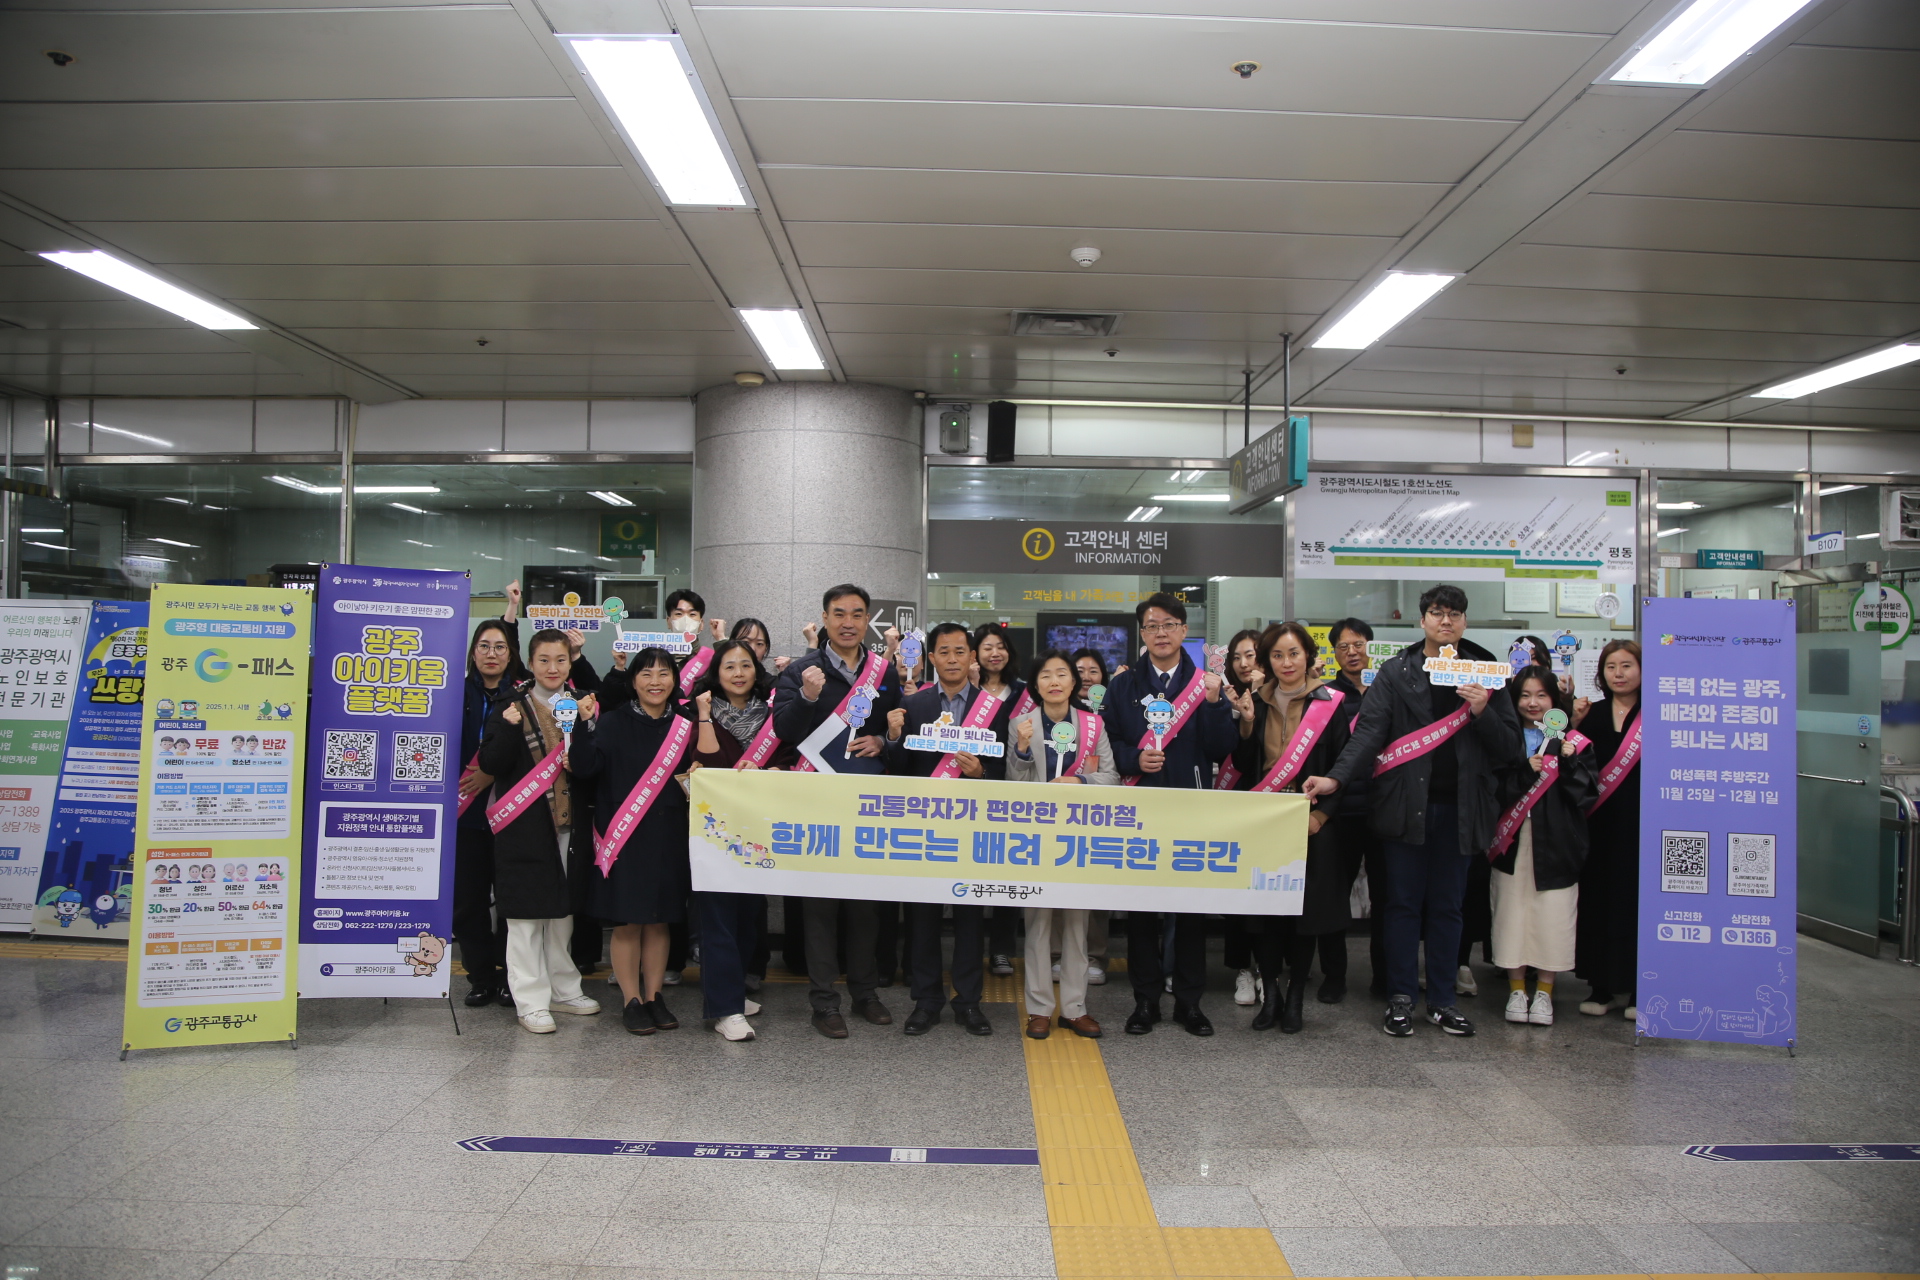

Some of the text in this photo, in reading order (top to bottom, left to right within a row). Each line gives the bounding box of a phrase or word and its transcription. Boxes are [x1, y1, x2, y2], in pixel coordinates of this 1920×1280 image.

[1246, 428, 1284, 474] 고객안내센터
[1247, 462, 1280, 494] INFORMATION
[1319, 477, 1453, 488] 광주광역시도시철도 1호선 노선도
[1320, 487, 1348, 495] Gwangju
[1348, 488, 1388, 496] Metropolitan
[1064, 530, 1168, 550] 고객안내 센터
[1818, 539, 1838, 550] B107
[1300, 541, 1326, 552] 녹동
[1609, 547, 1632, 558] 평동
[1709, 552, 1753, 561] 고객안내센터
[1075, 552, 1161, 565] INFORMATION
[1023, 588, 1124, 602] 고객님을 내 가족처럼
[166, 601, 195, 609] 광주시민
[198, 602, 219, 610] 모두가
[222, 603, 243, 611] 누리는
[246, 604, 259, 612] 교통
[339, 602, 369, 612] 아이낳아
[371, 604, 393, 613] 키우기
[394, 605, 409, 614] 좋은
[411, 606, 433, 615] 맘편한
[529, 607, 604, 618] 행복하고 안전한
[4, 615, 81, 625] 어르신의 행복한 노후!
[534, 620, 599, 630] 광주 대중교통
[7, 628, 73, 638] 우리의 미래입니다
[175, 621, 286, 635] 광주형 대중교통비 지원
[364, 628, 420, 656] 광주
[623, 633, 682, 642] 공공교통의 미래
[1742, 637, 1781, 646] 광주교통공사
[615, 642, 639, 650] 우리가
[0, 648, 72, 665] 광주광역시
[161, 658, 188, 671] 광주
[335, 656, 446, 686] 아이키움
[1433, 673, 1503, 687] 편한 도시 광주
[1658, 677, 1786, 699] 폭력 없는 광주,
[347, 686, 430, 714] 플랫폼
[1660, 704, 1779, 725] 배려와 존중이
[159, 722, 201, 730] 어린이, 청소년
[923, 727, 995, 742] 내 일이 빛나는
[195, 739, 219, 749] 무료
[263, 739, 287, 749] 반값
[1670, 730, 1769, 751] 빛나는 사회
[906, 738, 1002, 755] 새로운 대중교통 시대
[1670, 768, 1770, 784] 여성폭력 추방주간
[408, 784, 426, 792] 유튜브
[1660, 787, 1779, 804] 11월 25일 12월 1일
[857, 794, 1143, 829] 교통약자가 편안한 지하철,
[343, 813, 420, 823] 광주광역시 생애주기별
[2, 822, 41, 833] 상담 가능
[337, 824, 424, 833] 지원정책 안내 통합플랫폼
[771, 821, 1241, 874] 함께 만드는 배려 가득한 공간
[13, 867, 38, 876] 자치구
[971, 882, 1043, 900] 광주교통공사
[148, 904, 168, 914] 30%
[183, 903, 203, 912] 20%
[218, 902, 237, 911] 50%
[252, 901, 271, 910] 64%
[346, 909, 410, 917] www.광주아이키움.kr
[1664, 911, 1702, 921] 신고전화
[1731, 914, 1771, 925] 상담전화
[316, 921, 340, 929] 상담전화
[398, 922, 431, 930] 223-1279
[1681, 927, 1700, 940] 112
[1740, 930, 1771, 944] 1366
[355, 966, 396, 974] 광주아이키움
[185, 1014, 257, 1031] 광주교통공사
